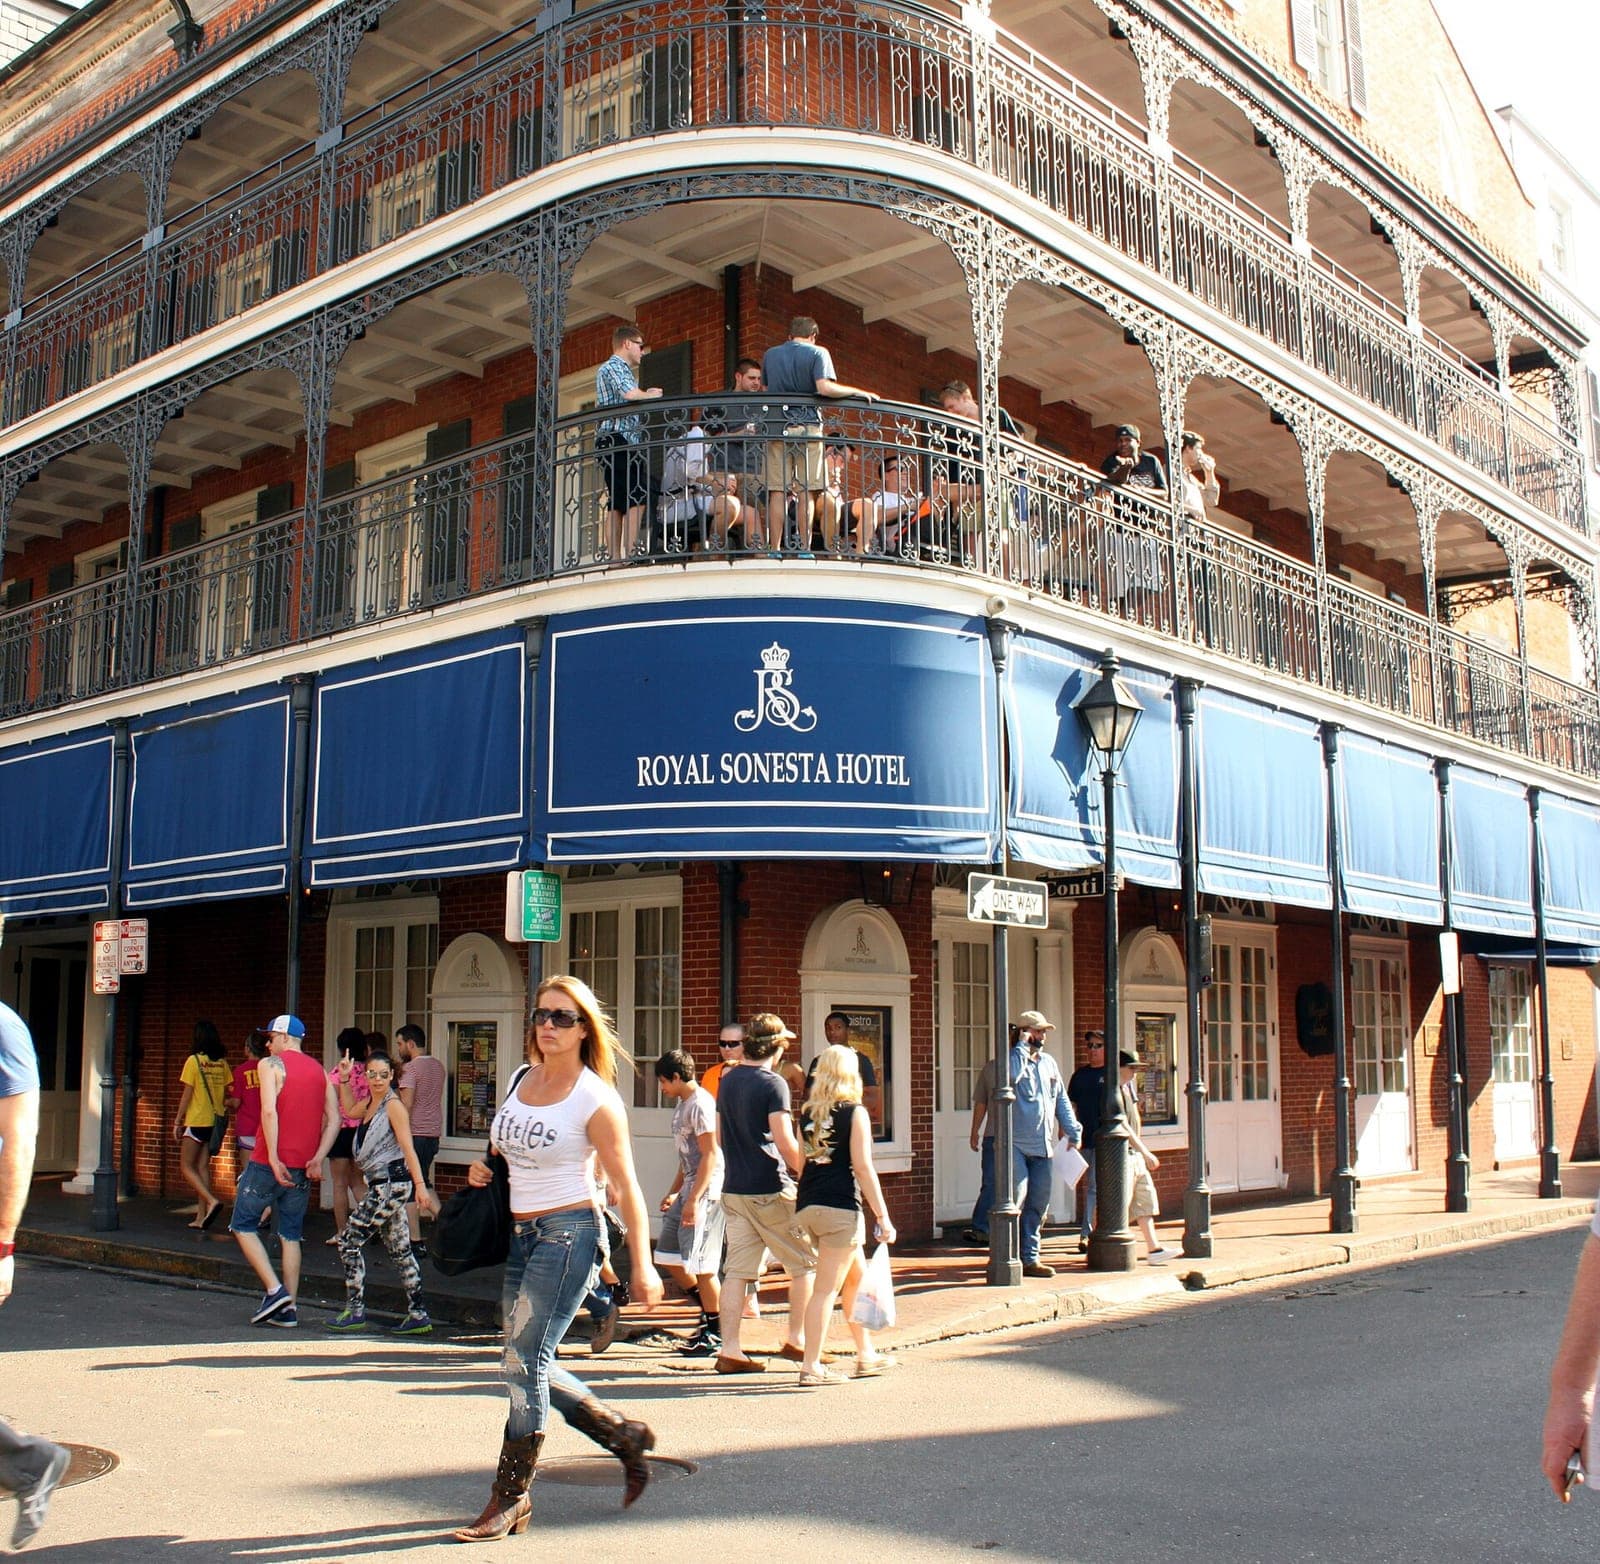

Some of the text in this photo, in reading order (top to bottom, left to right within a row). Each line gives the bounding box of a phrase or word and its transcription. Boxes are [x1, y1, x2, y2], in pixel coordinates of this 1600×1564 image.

[637, 752, 910, 786] ROYAL SONESTA HOTEL
[532, 890, 555, 898] ALLOWED
[1047, 877, 1097, 897] Conti
[540, 897, 557, 905] STREET
[992, 892, 1038, 912] ONE WAY
[123, 945, 144, 953] CORNER
